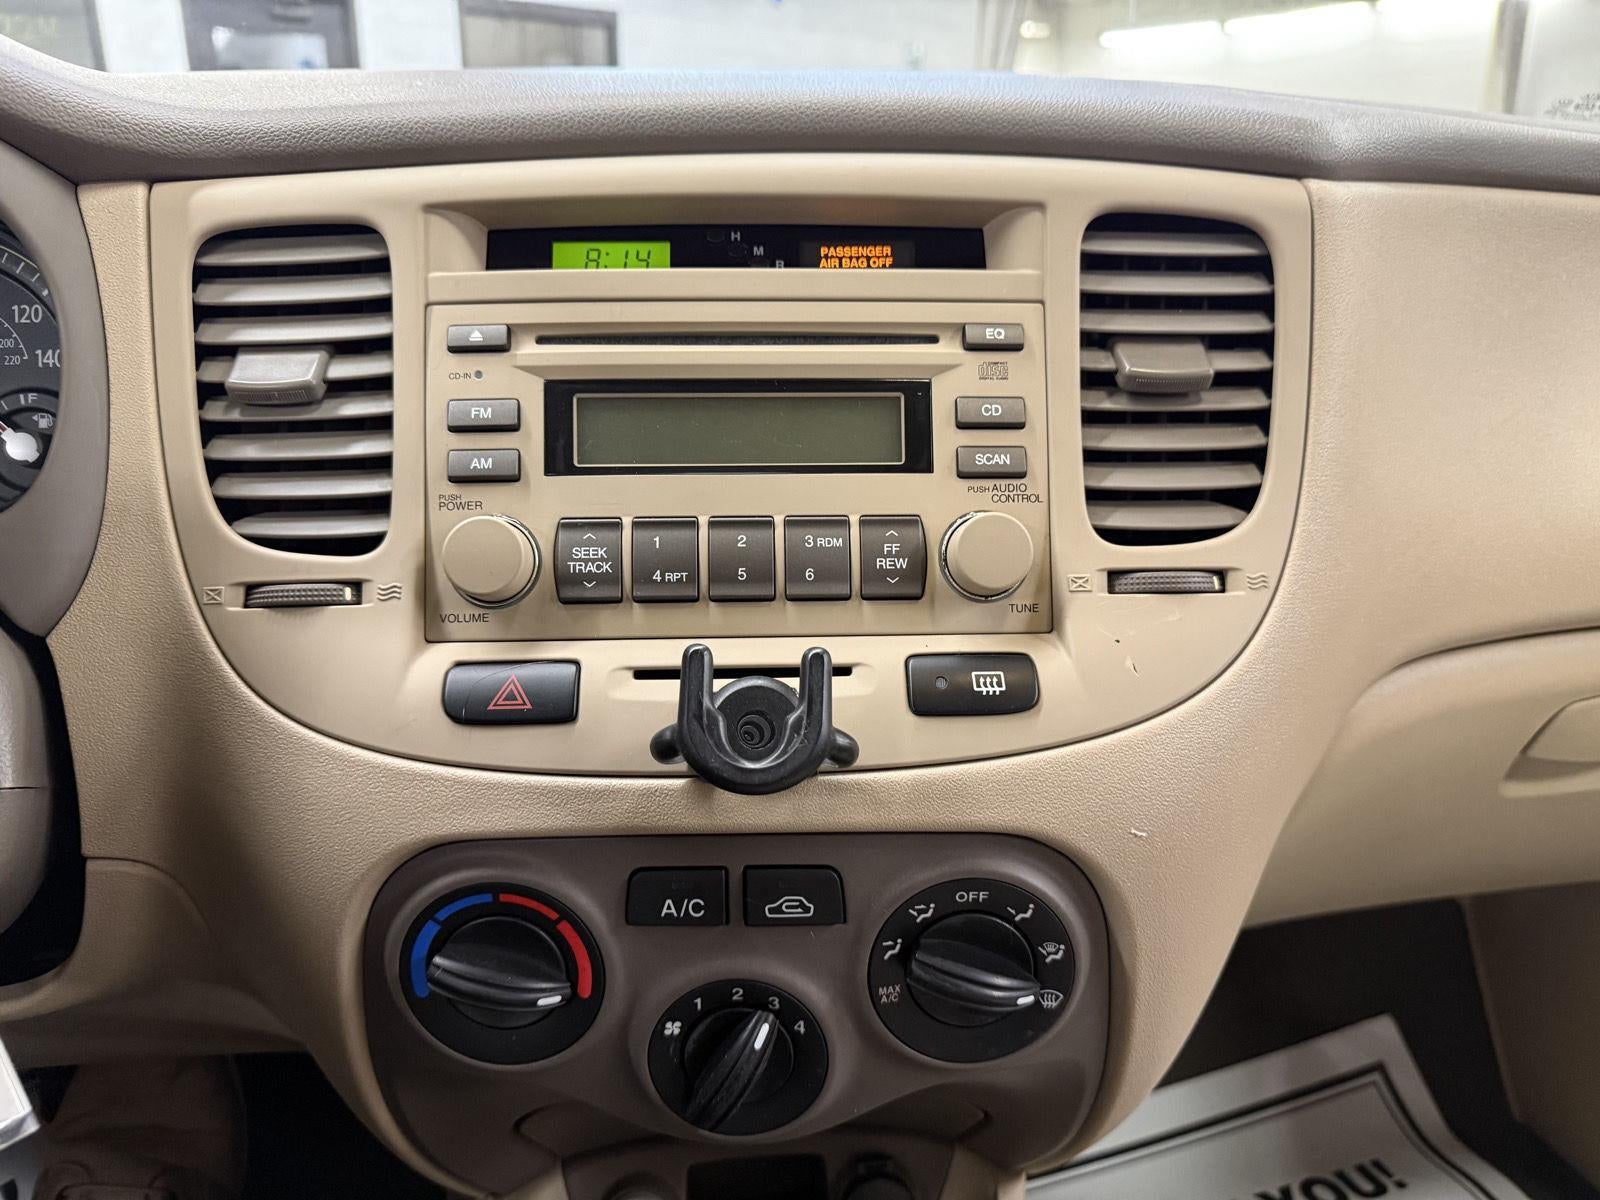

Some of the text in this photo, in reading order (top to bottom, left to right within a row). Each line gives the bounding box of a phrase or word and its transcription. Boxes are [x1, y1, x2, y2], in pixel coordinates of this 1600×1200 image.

[731, 231, 741, 242] H
[753, 246, 764, 256] M
[820, 246, 892, 257] PASSENGER
[820, 257, 893, 268] AIR BAG OFF
[11, 304, 43, 324] 120
[985, 327, 1005, 339] EQ
[4, 355, 21, 366] 220
[448, 372, 472, 380] CD-IN
[471, 407, 492, 419] FM
[981, 404, 1002, 416] CD
[470, 457, 493, 470] AM
[975, 453, 1010, 465] SCAN
[967, 483, 1028, 493] PUSH AUDIO
[991, 493, 1044, 504] CONTROL
[438, 500, 483, 511] POWER
[653, 536, 660, 549] 1
[737, 535, 747, 548] 2
[804, 535, 843, 548] 3 RDM
[572, 547, 608, 559] SEEK
[883, 543, 901, 555] FF
[567, 561, 613, 574] TRACK
[876, 557, 908, 570] REW
[652, 569, 689, 583] 4 RPT
[737, 568, 747, 581] 5
[805, 568, 815, 581] 6
[1008, 603, 1040, 613] TUNE
[439, 612, 490, 624] VOLUME
[955, 891, 989, 903] OFF
[661, 899, 705, 918] A/C
[731, 987, 744, 1001] 2
[878, 984, 901, 996] MAX
[693, 997, 702, 1011] 1
[767, 996, 780, 1010] 3
[880, 993, 899, 1005] A/C
[793, 1020, 806, 1035] 4
